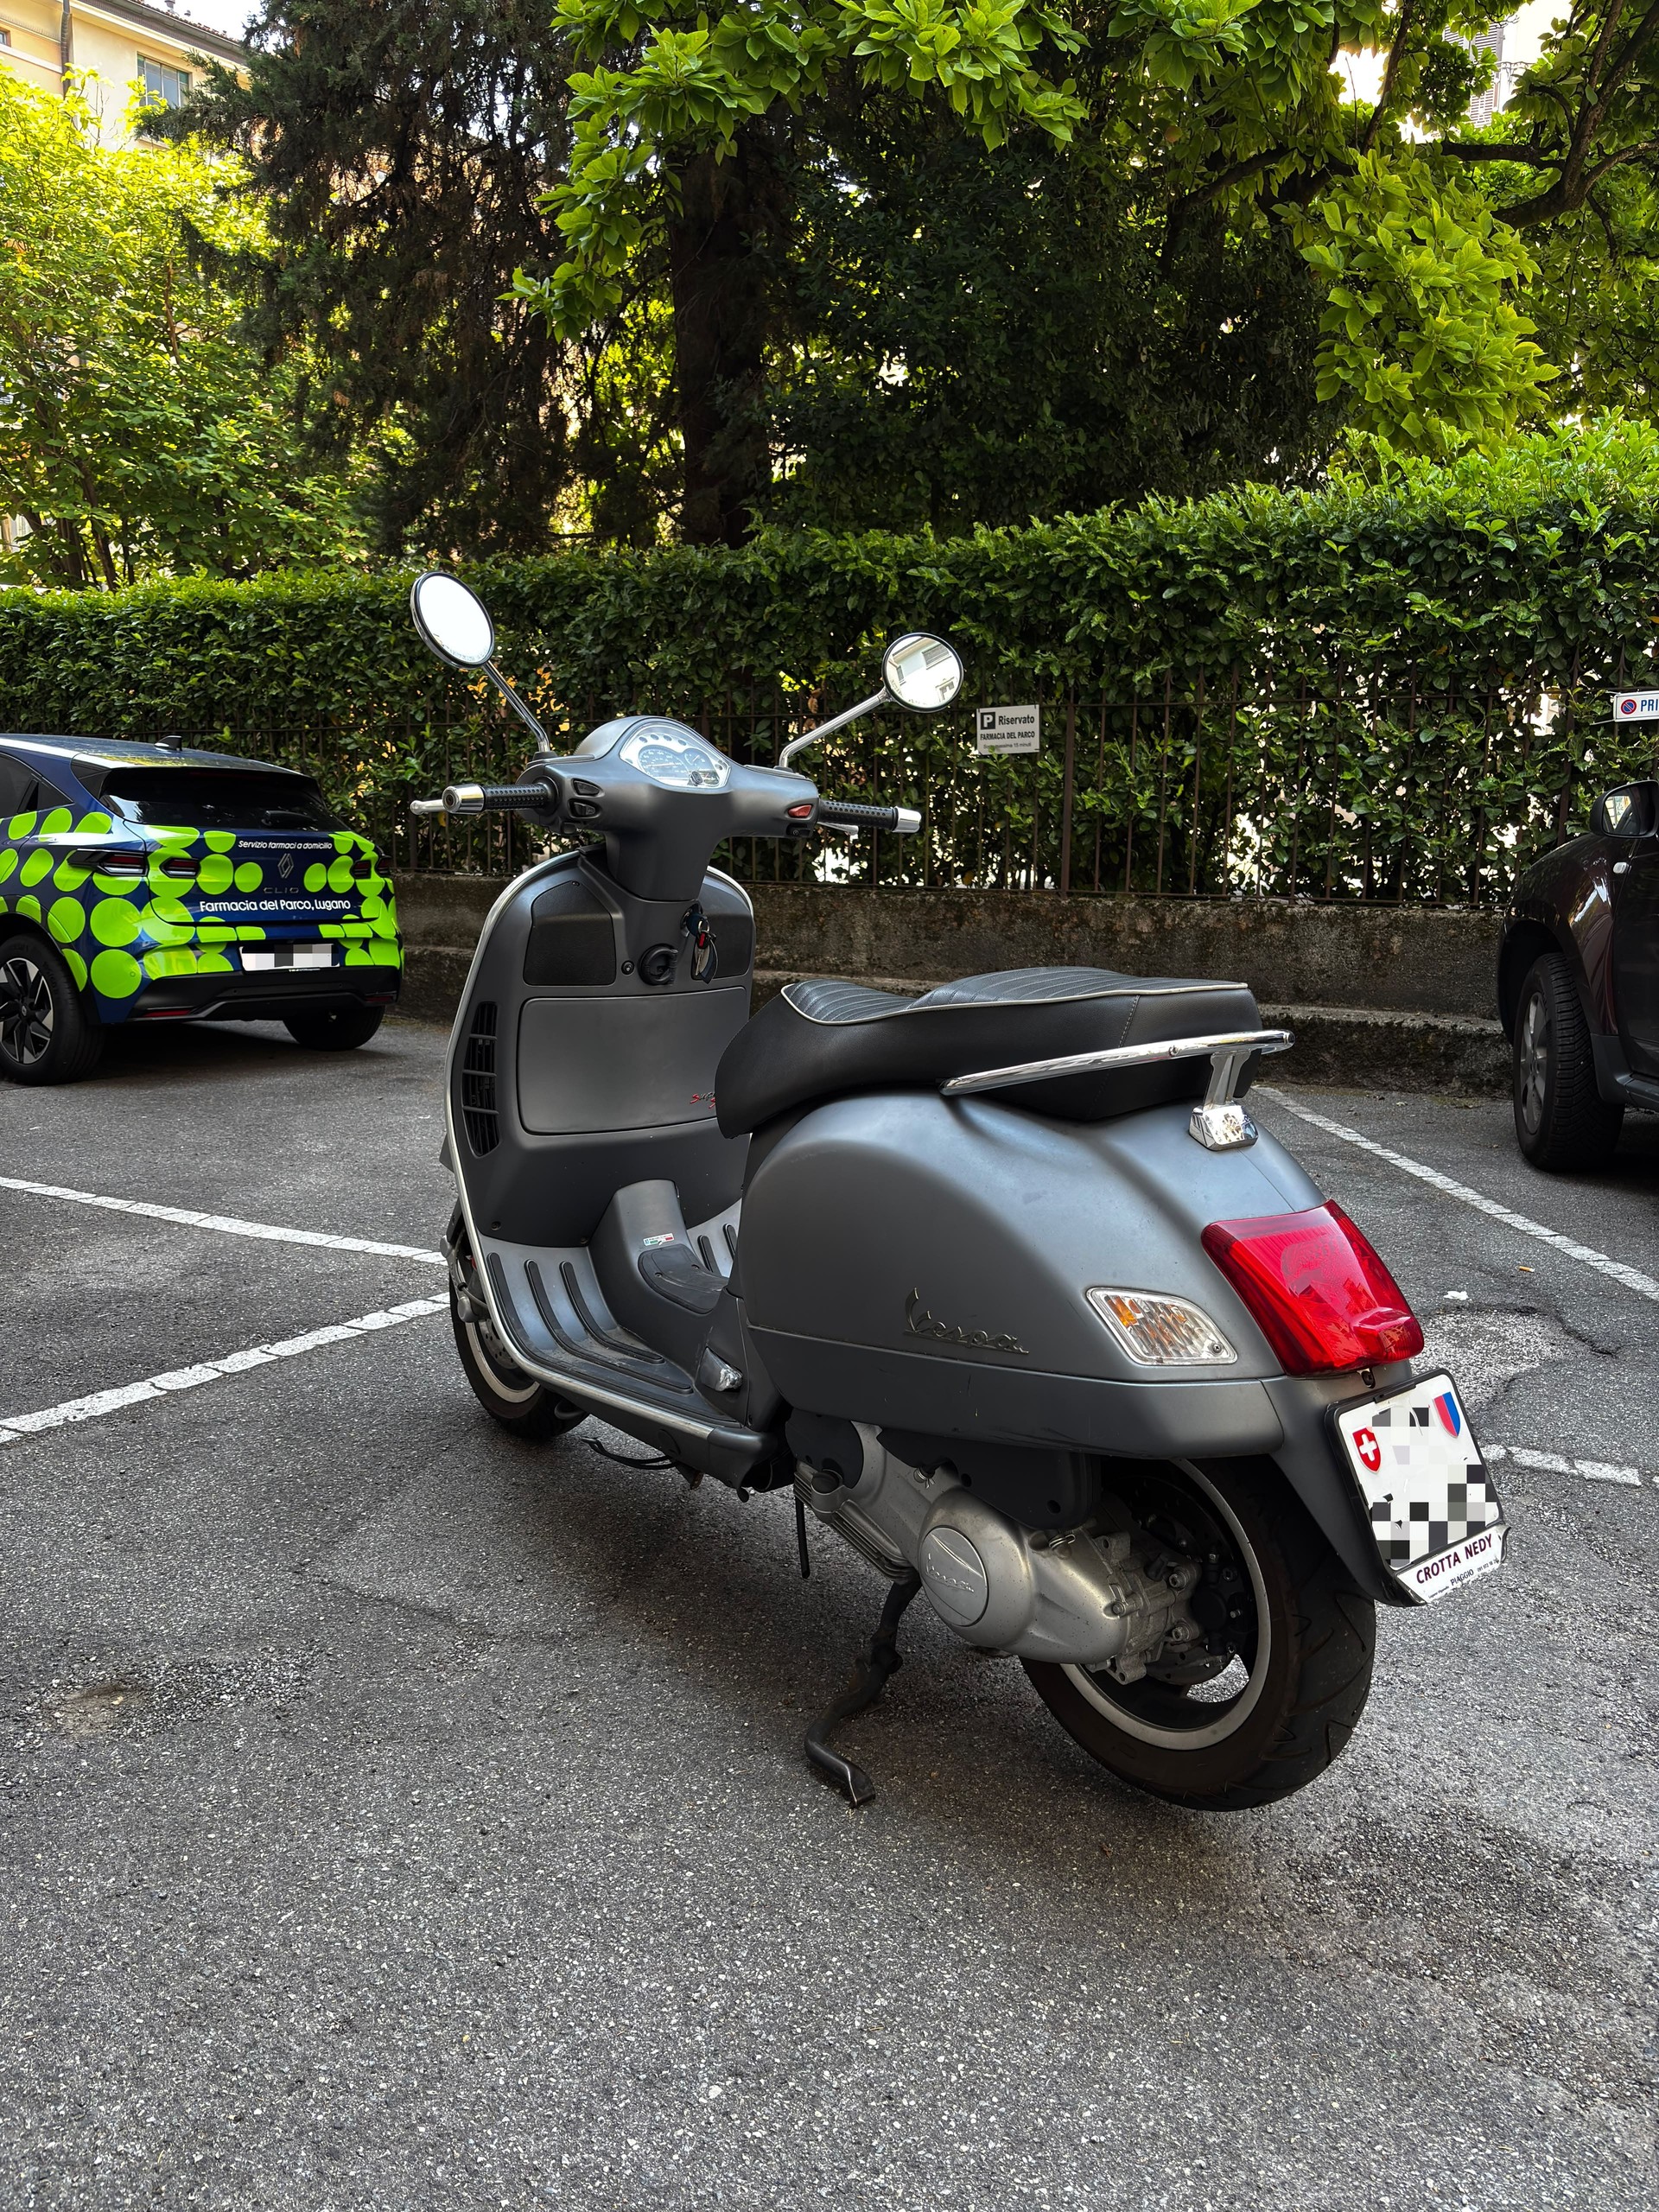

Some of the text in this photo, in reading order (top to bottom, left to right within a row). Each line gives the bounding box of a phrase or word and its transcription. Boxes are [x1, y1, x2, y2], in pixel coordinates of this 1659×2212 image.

[1641, 699, 1658, 711] PRI
[983, 715, 1035, 728] P Riservato
[980, 732, 1006, 741] FARMACIA
[238, 840, 267, 849] Servizio
[200, 899, 351, 912] Farmacia del Parco, Lugano
[905, 1287, 1029, 1354] Vespa
[1416, 1533, 1491, 1584] CROTTA NEDY
[1450, 1569, 1474, 1586] PIAGGIO
